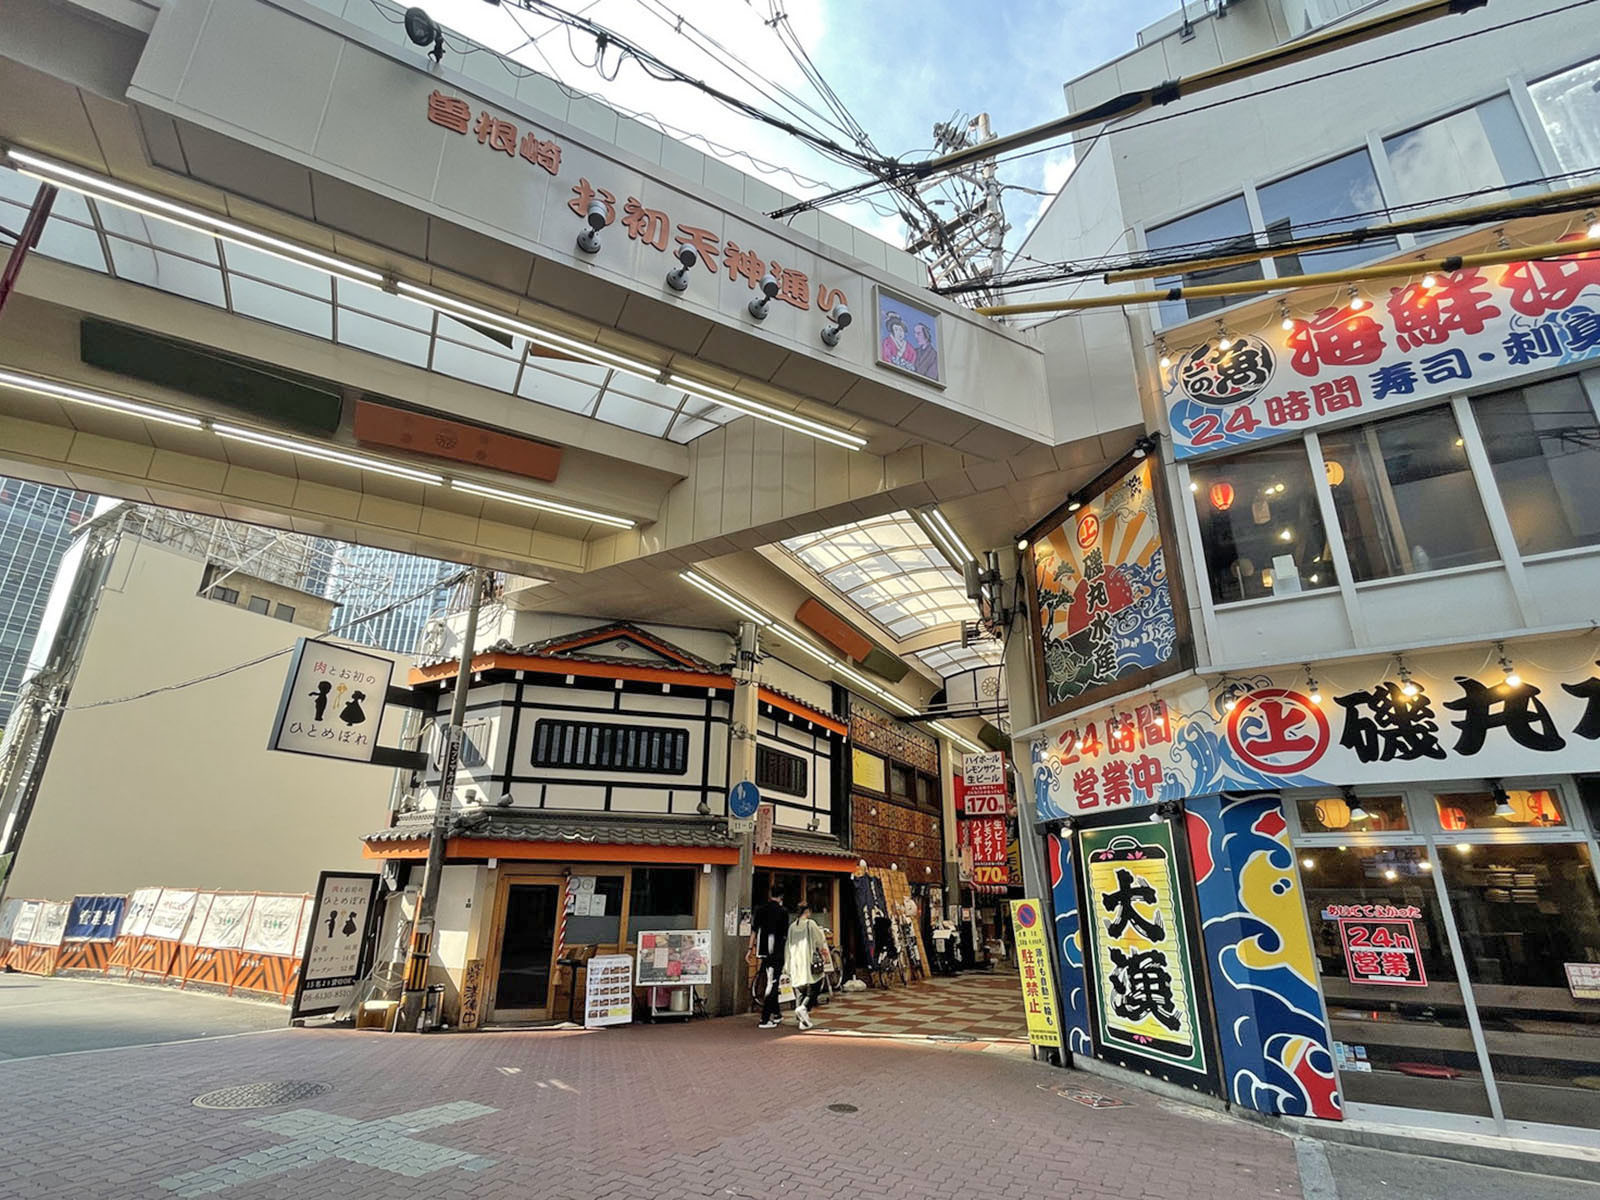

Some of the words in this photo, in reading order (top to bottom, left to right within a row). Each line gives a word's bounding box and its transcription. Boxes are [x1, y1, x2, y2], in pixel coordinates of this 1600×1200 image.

[568, 177, 849, 322] お初天神通り
[1189, 375, 1364, 446] 24時間
[1083, 546, 1117, 678] 磯丸水産
[313, 661, 376, 685] 肉とお初の
[289, 721, 369, 746] ひとめぼれ
[1059, 699, 1172, 765] 24時間
[965, 754, 1000, 765] ハイボール
[965, 764, 1001, 774] レモンサワー
[967, 774, 1001, 785] 生ビール
[1073, 754, 1163, 810] 営業中
[972, 820, 983, 861] ハイボール
[983, 820, 993, 861] レモンサワー
[993, 820, 1004, 861] 生ビール
[323, 896, 367, 905] ひとめぼれ
[1101, 868, 1182, 1032] 大漁
[1352, 951, 1411, 977] 営業
[1021, 948, 1042, 1014] 駐車禁止
